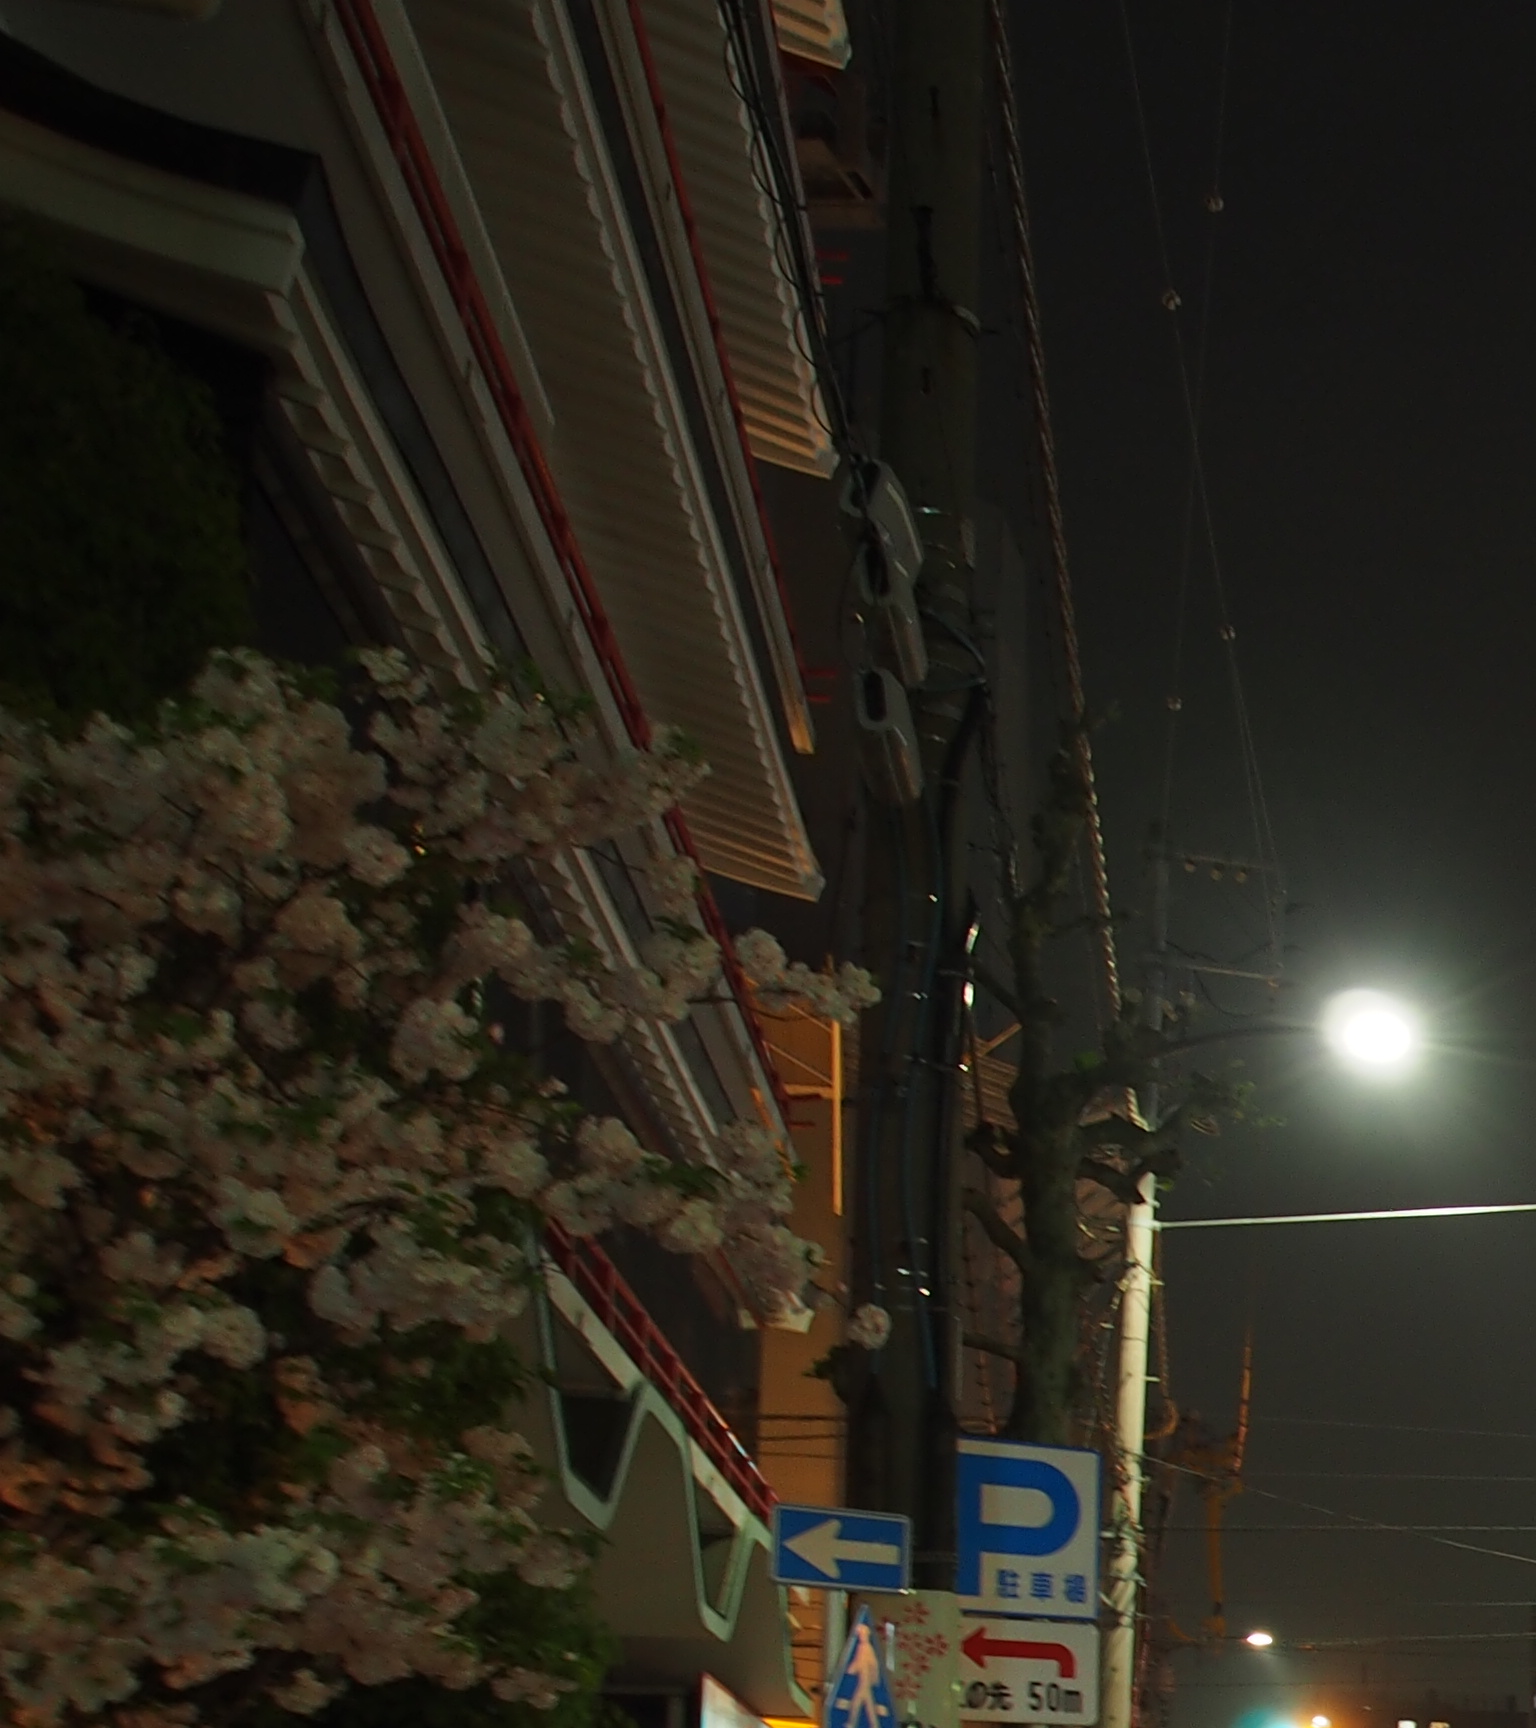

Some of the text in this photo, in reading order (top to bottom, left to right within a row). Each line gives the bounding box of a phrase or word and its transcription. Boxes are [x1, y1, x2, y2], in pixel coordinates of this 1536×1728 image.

[956, 1454, 1081, 1596] P
[996, 1568, 1089, 1605] 駐車場
[959, 1681, 1085, 1715] の先 50m
